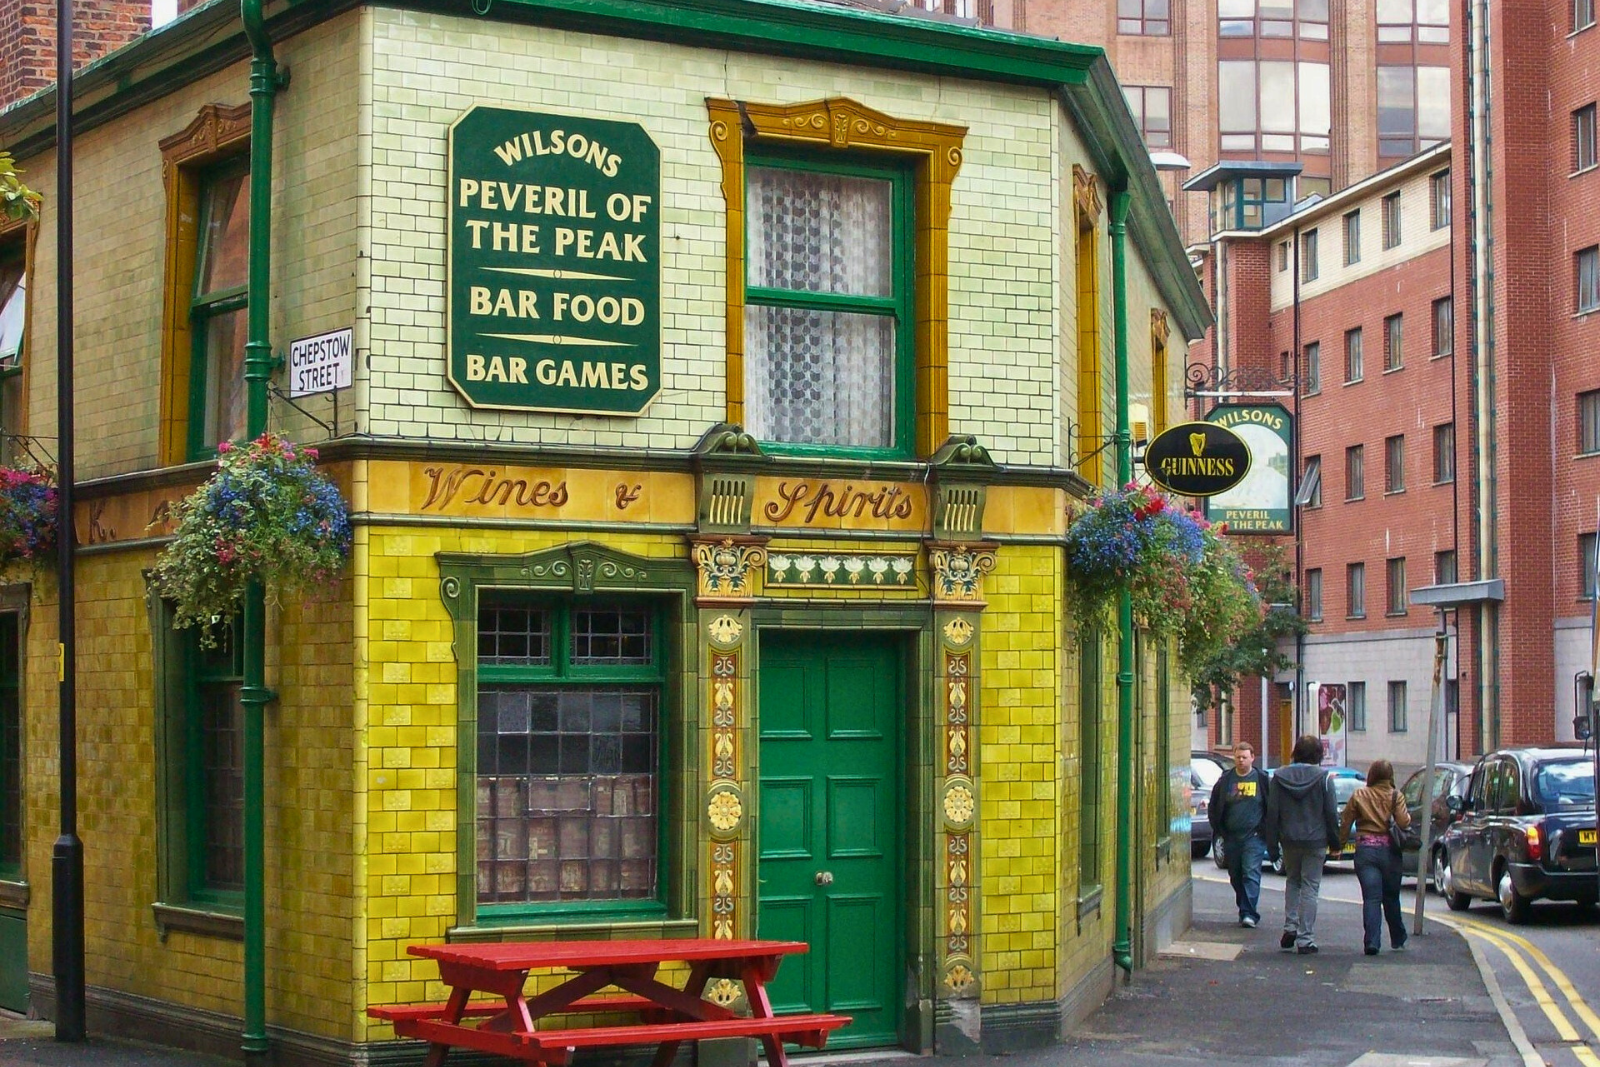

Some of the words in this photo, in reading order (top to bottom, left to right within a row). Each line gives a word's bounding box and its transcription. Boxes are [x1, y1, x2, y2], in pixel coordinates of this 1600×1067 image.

[494, 129, 622, 178] WILSONS
[459, 178, 597, 219] PEVERIL
[606, 193, 652, 223] OF
[465, 219, 540, 254] THE
[555, 227, 648, 263] PEAK
[469, 286, 540, 319] BAR
[553, 292, 645, 326] FOOD
[292, 334, 350, 367] CHEPSTOW
[299, 362, 340, 391] STREET
[466, 354, 529, 384] BAR
[535, 359, 649, 391] GAMES
[1212, 409, 1283, 430] WILSONS
[1160, 457, 1235, 477] GUINNESS
[421, 467, 569, 511] Wines
[615, 482, 642, 510] &
[764, 481, 912, 523] Spirits
[1226, 510, 1270, 519] PEVERIL
[1233, 520, 1254, 530] THE
[1255, 520, 1283, 531] PEAK
